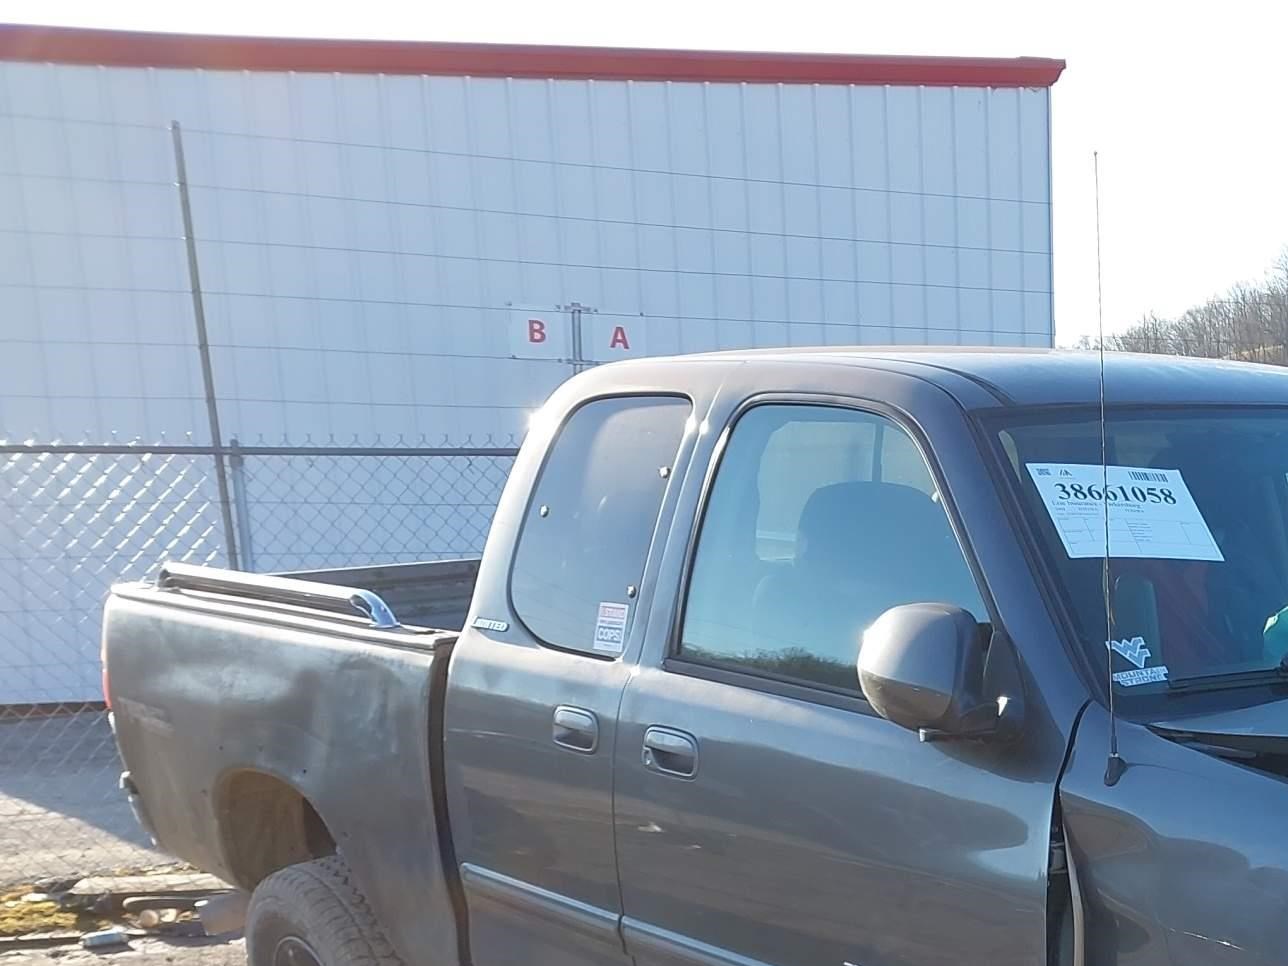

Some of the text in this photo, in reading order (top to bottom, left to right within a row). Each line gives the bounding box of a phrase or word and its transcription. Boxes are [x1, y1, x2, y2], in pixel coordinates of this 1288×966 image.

[528, 320, 630, 349] B A
[1053, 482, 1177, 505] 38661058
